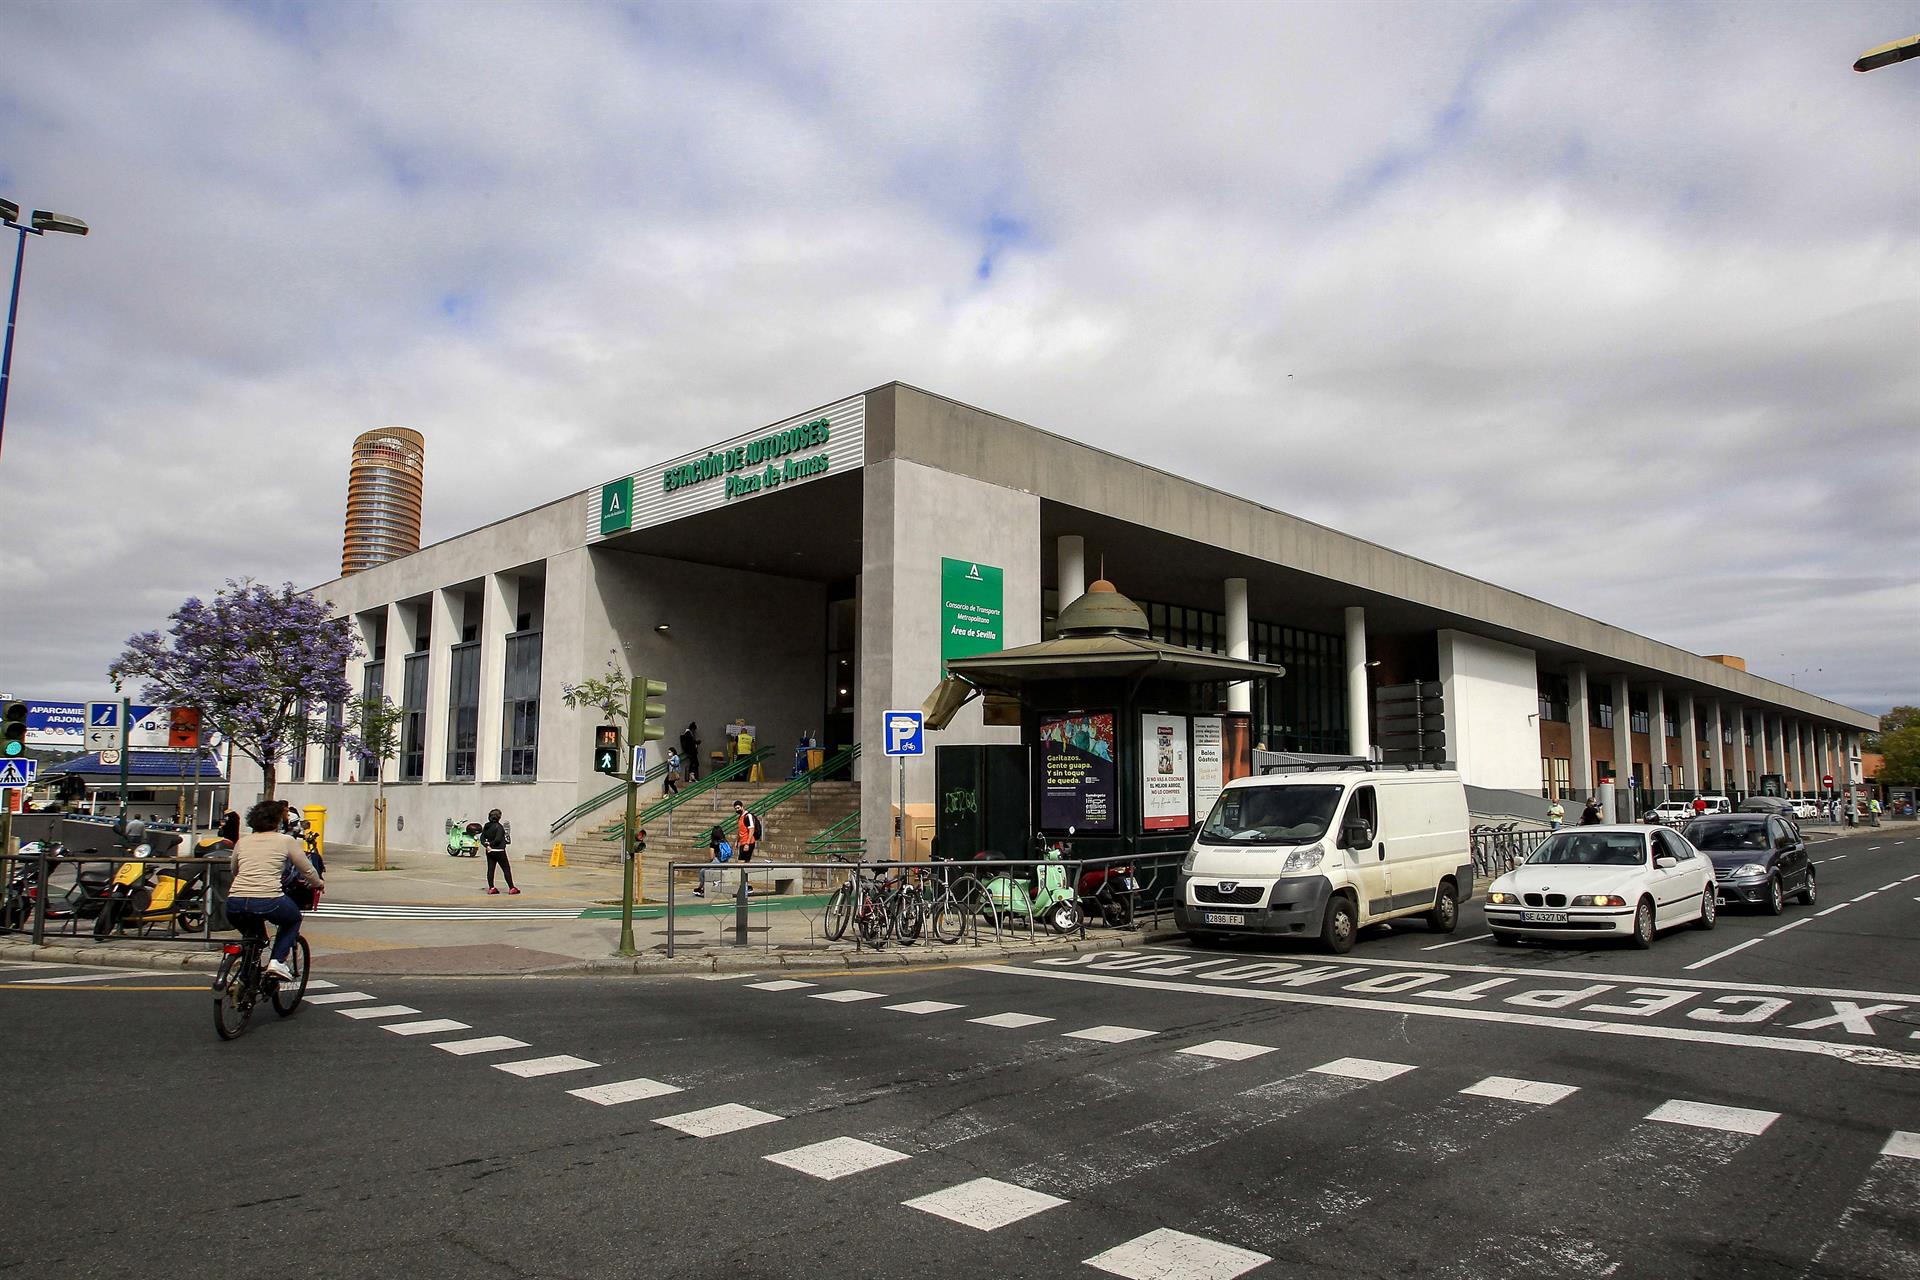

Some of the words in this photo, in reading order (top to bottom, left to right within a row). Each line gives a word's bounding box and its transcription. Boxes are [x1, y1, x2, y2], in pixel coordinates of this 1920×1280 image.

[663, 451, 724, 492] ESTACIÓN
[725, 446, 745, 472] DE
[745, 418, 830, 466] AUTOBUSES
[725, 474, 761, 499] Plaza
[763, 464, 780, 488] de
[782, 453, 829, 483] Armas
[945, 600, 970, 611] Consorcio
[976, 605, 1001, 616] Transporte
[951, 624, 966, 636] Área
[967, 628, 976, 637] de
[976, 630, 996, 640] Sevilla
[30, 706, 84, 715] APARCAMIE
[47, 716, 84, 724] ARJONA
[1057, 777, 1081, 785] queda.
[1033, 950, 1372, 986] MOTOS
[1340, 972, 1920, 1039] XCEPTO
